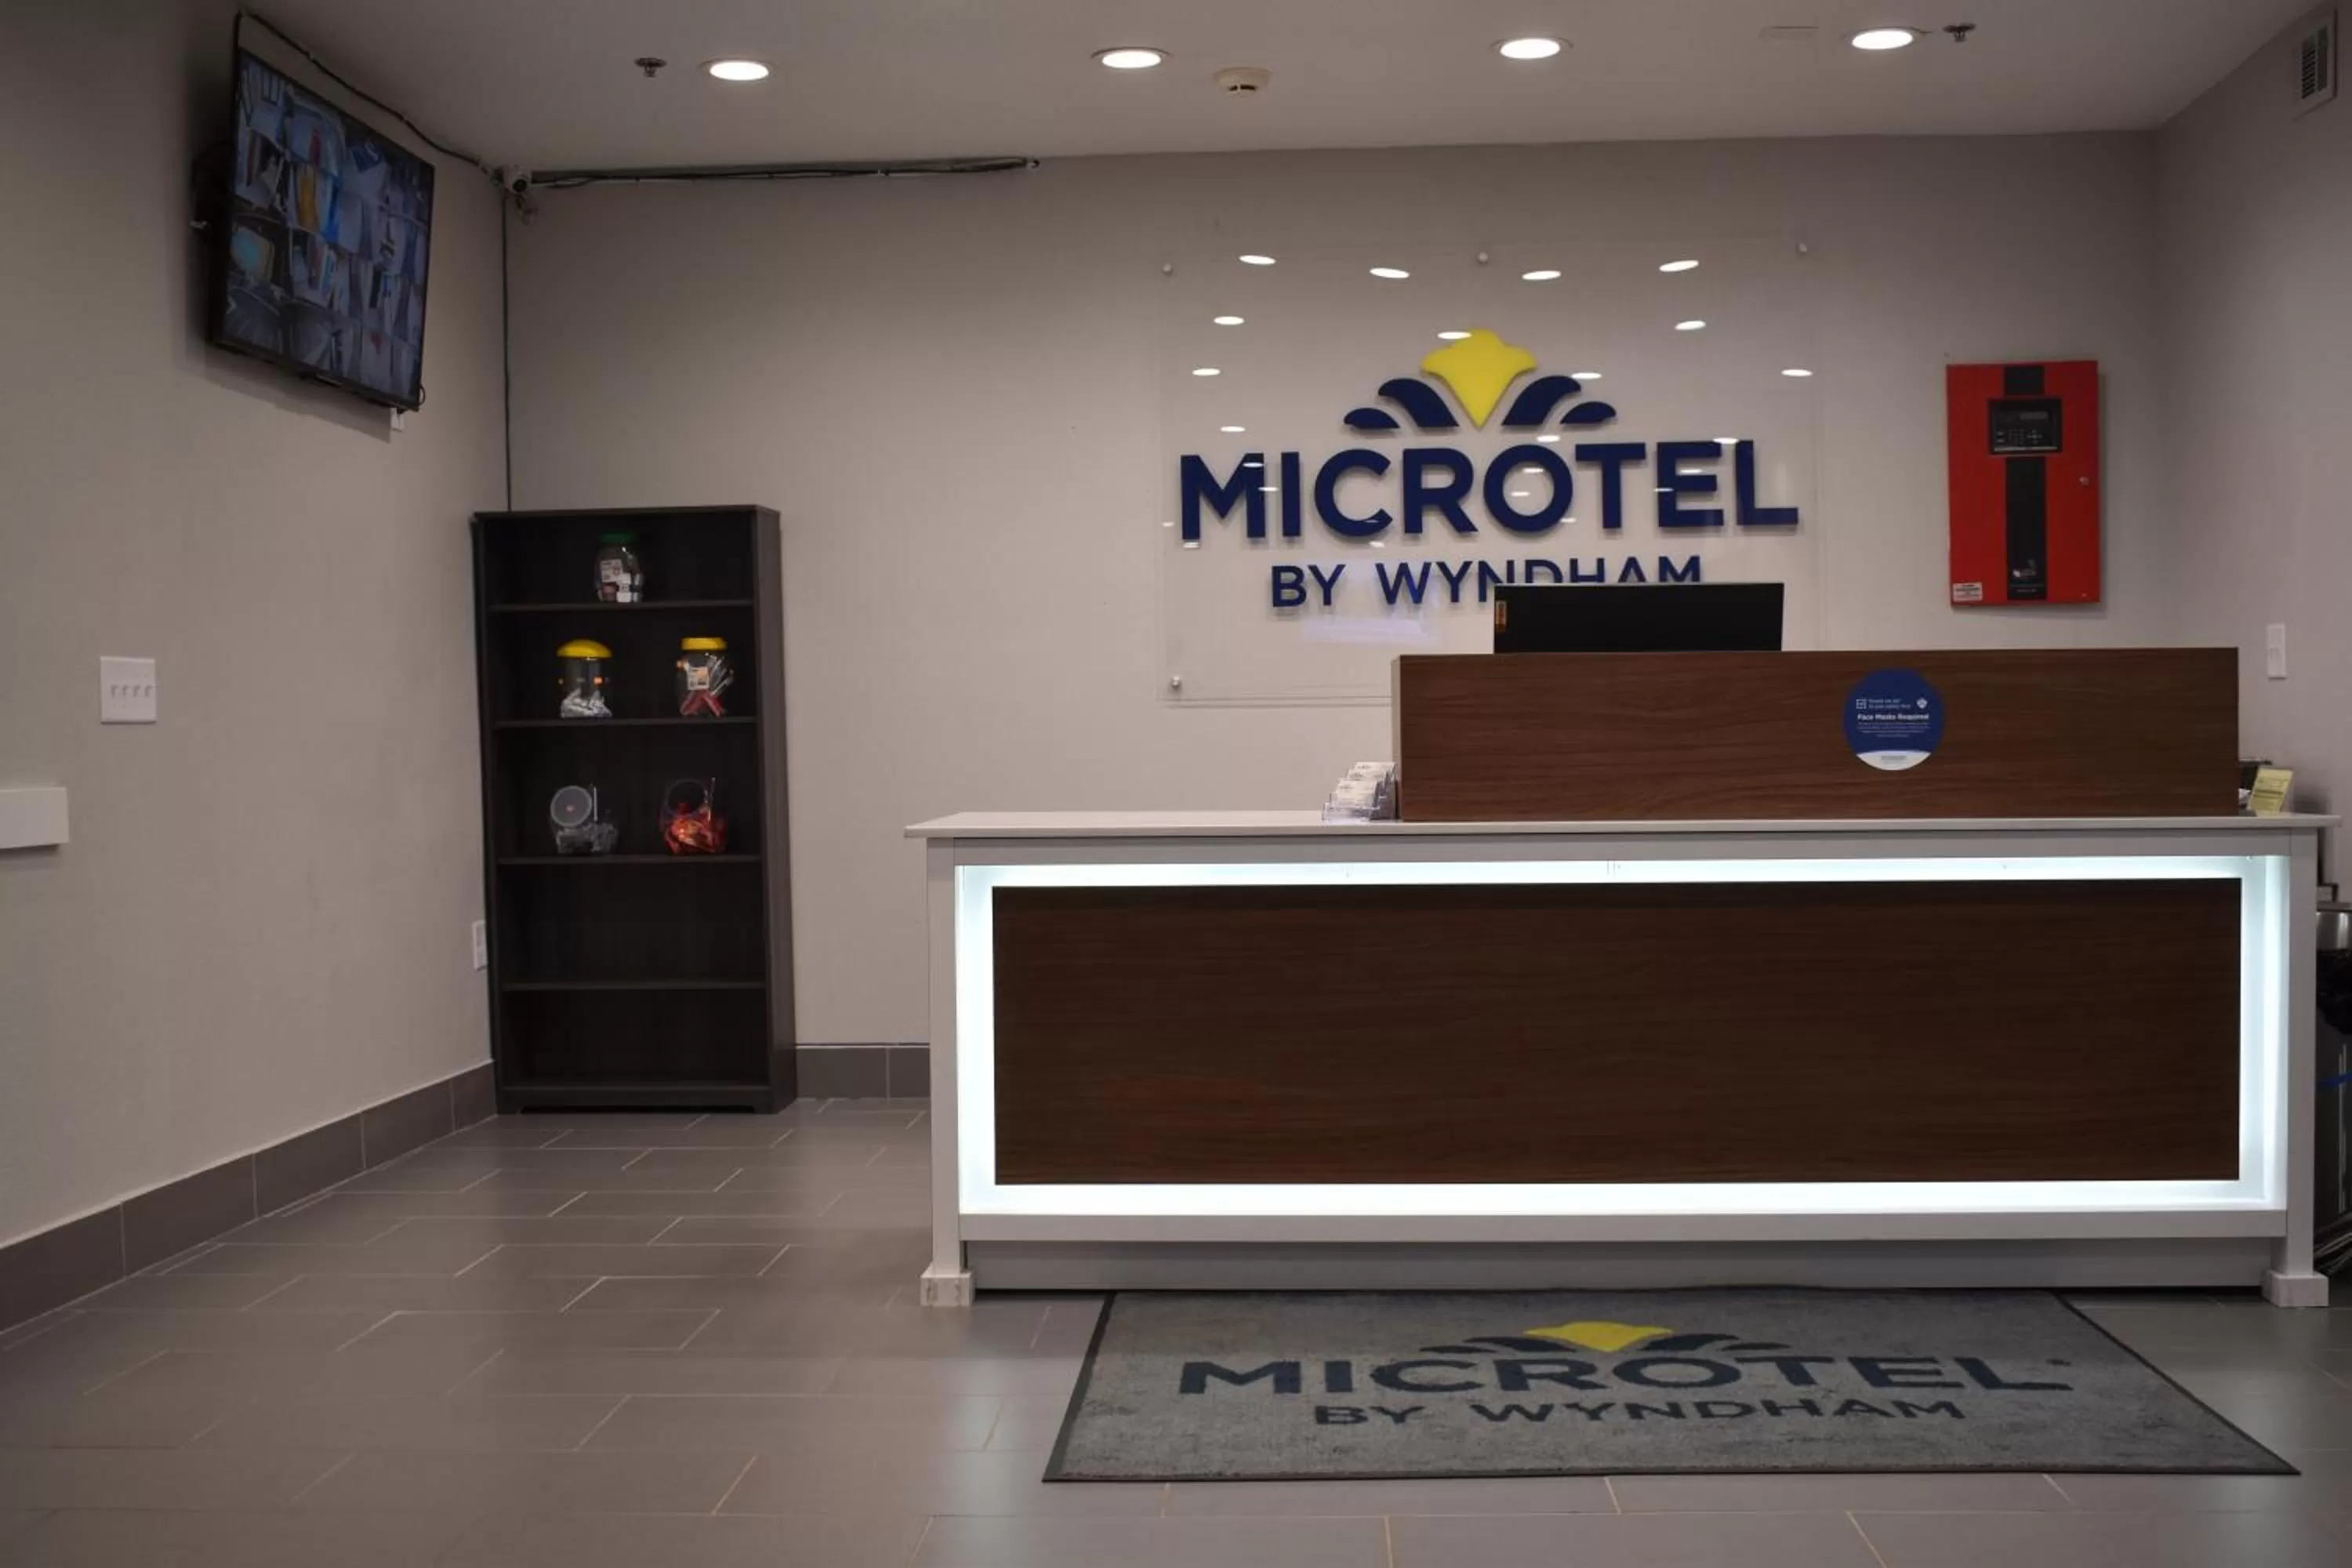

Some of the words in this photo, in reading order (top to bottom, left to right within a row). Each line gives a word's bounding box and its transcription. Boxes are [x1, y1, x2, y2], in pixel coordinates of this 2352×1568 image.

[1180, 440, 1798, 540] MICROTEL
[1271, 564, 1345, 608] BY
[1375, 555, 1701, 605] WYNDHAM
[1179, 1356, 2074, 1394] MICROTEL
[1314, 1404, 1425, 1425] BY
[1469, 1399, 1965, 1423] WYNDHAM
